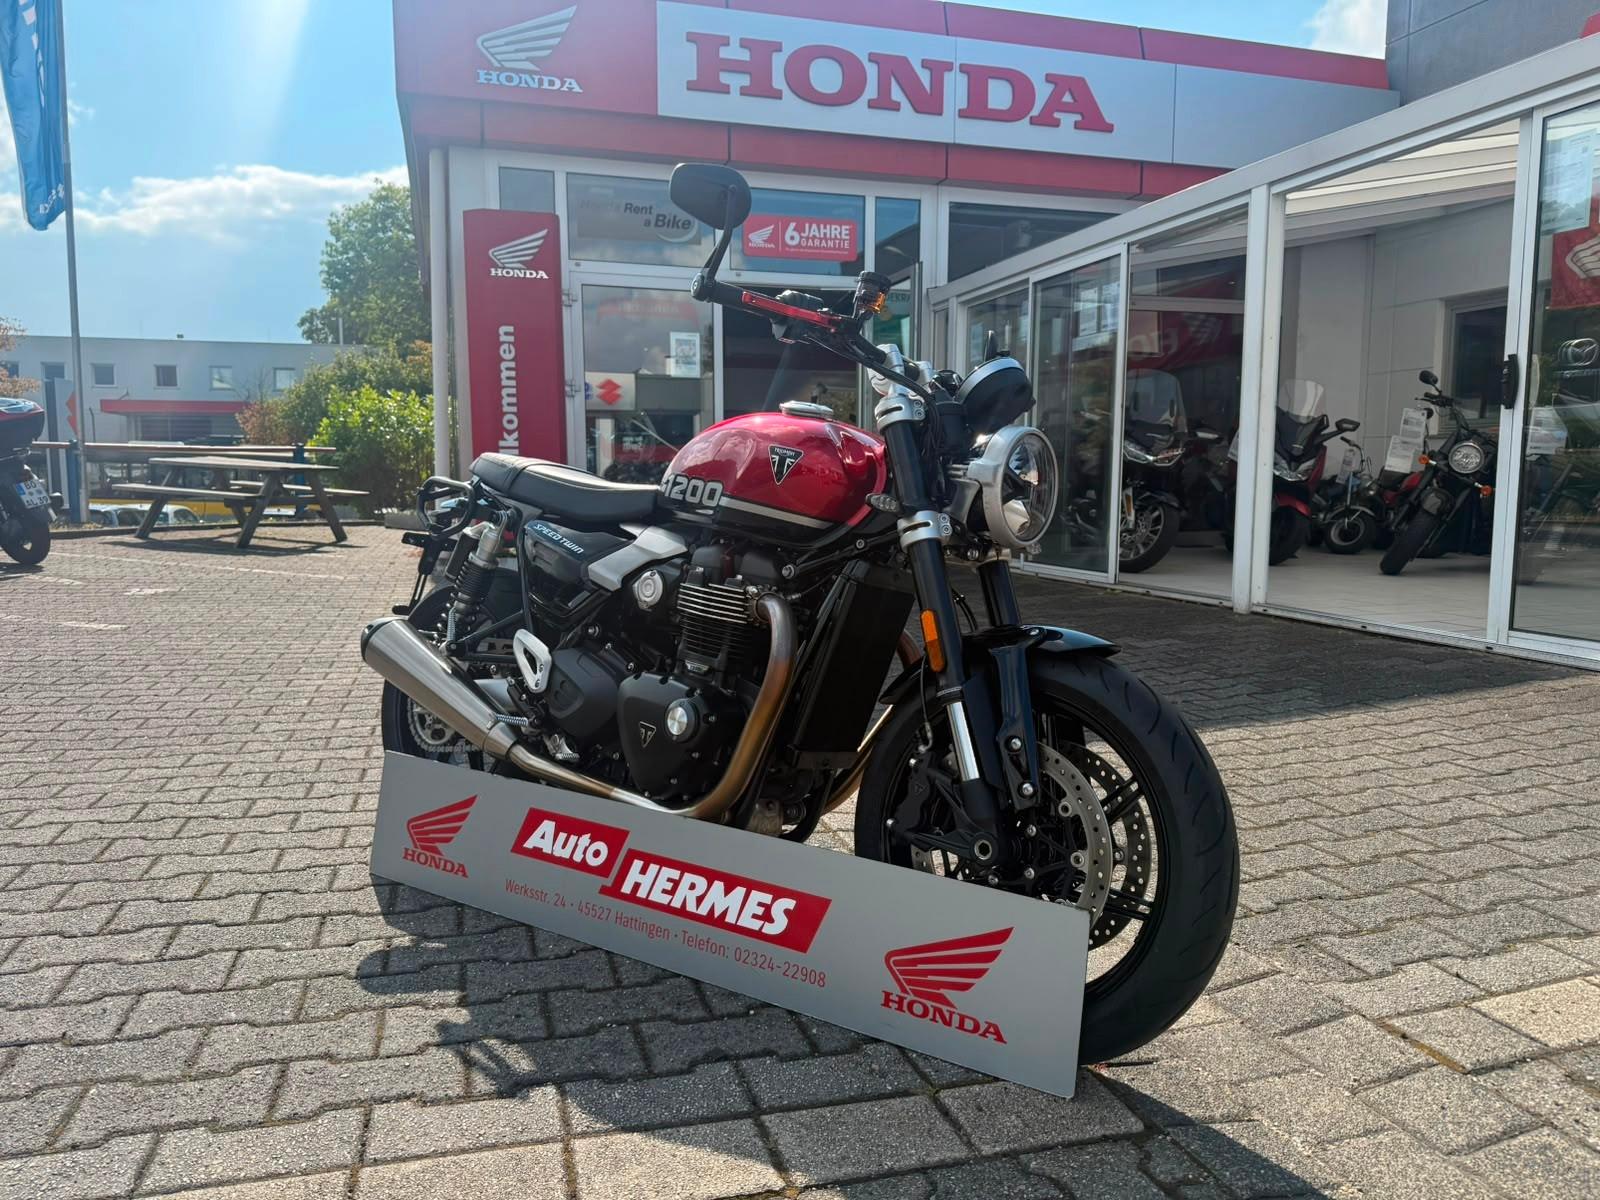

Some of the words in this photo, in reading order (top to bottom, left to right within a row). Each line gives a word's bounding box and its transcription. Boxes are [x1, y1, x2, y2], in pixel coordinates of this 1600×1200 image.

[476, 69, 583, 93] HONDA
[686, 31, 1114, 133] HONDA
[623, 202, 653, 215] Rent
[643, 218, 651, 228] a
[654, 213, 692, 230] Bike
[784, 222, 800, 246] 6
[800, 223, 850, 239] JAHRE
[800, 238, 850, 249] GARANTIE
[490, 267, 549, 279] HONDA
[498, 325, 519, 455] lkommen
[663, 473, 723, 507] 1200
[534, 524, 562, 541] SPEED
[523, 819, 609, 867] Auto
[403, 847, 469, 878] HONDA
[620, 858, 797, 935] HERMES
[505, 878, 549, 903] Werksstr.
[553, 893, 567, 909] 24
[577, 900, 612, 921] 45527
[615, 911, 670, 942] Hattingen
[681, 930, 729, 959] Telefon:
[734, 946, 827, 988] 02324-22908
[881, 990, 1008, 1045] HONDA
